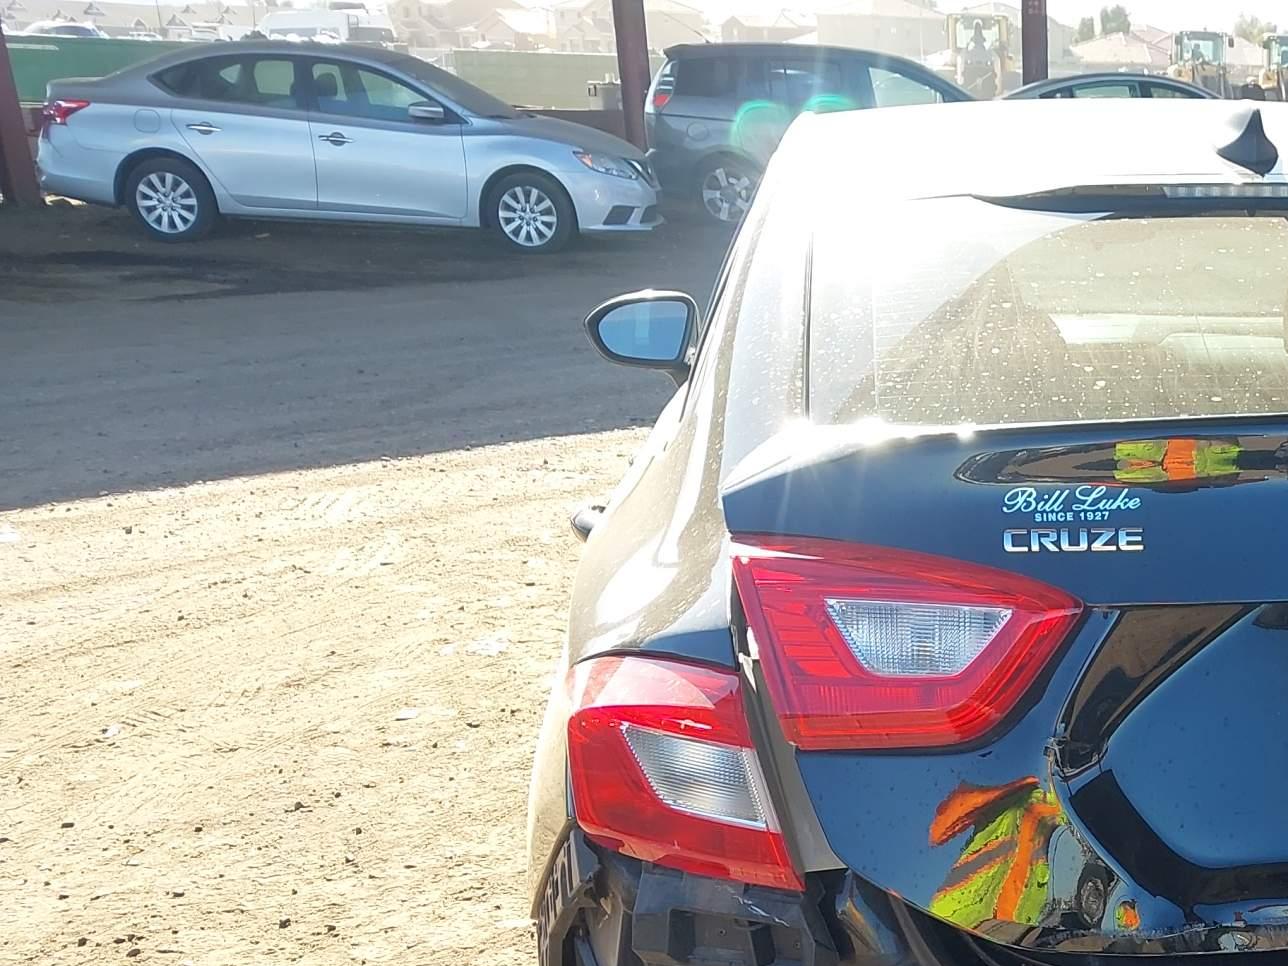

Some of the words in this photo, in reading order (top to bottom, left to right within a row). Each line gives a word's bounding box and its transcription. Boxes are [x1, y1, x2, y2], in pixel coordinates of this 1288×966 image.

[1002, 487, 1069, 512] Bill
[1072, 486, 1141, 510] Luke
[1034, 512, 1073, 521] SINCE
[1079, 511, 1109, 520] 1927
[1003, 528, 1144, 551] CRUZE
